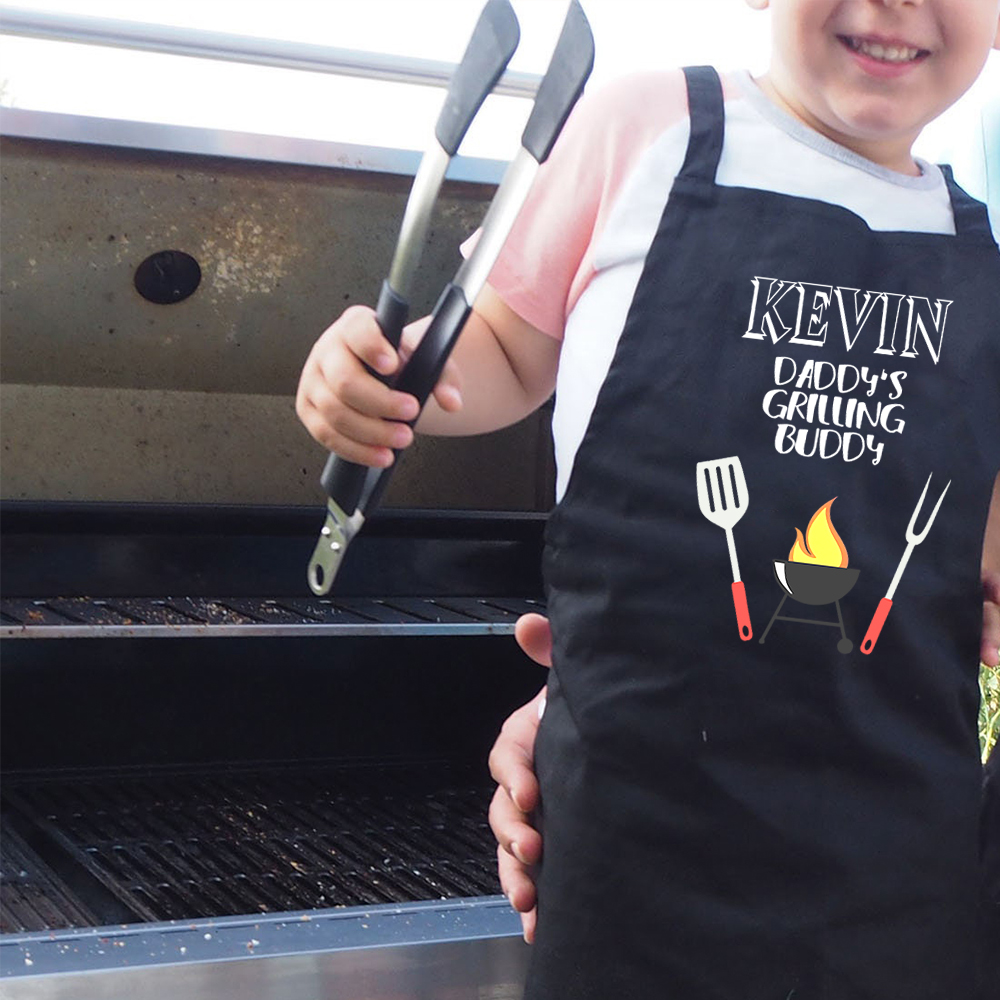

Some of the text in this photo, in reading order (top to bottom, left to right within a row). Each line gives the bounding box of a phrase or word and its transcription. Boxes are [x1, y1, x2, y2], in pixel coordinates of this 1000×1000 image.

[742, 276, 953, 365] KEVIN
[774, 357, 907, 400] DADDY'S
[763, 389, 905, 434] GRILLING
[775, 424, 884, 465] BUDDY
